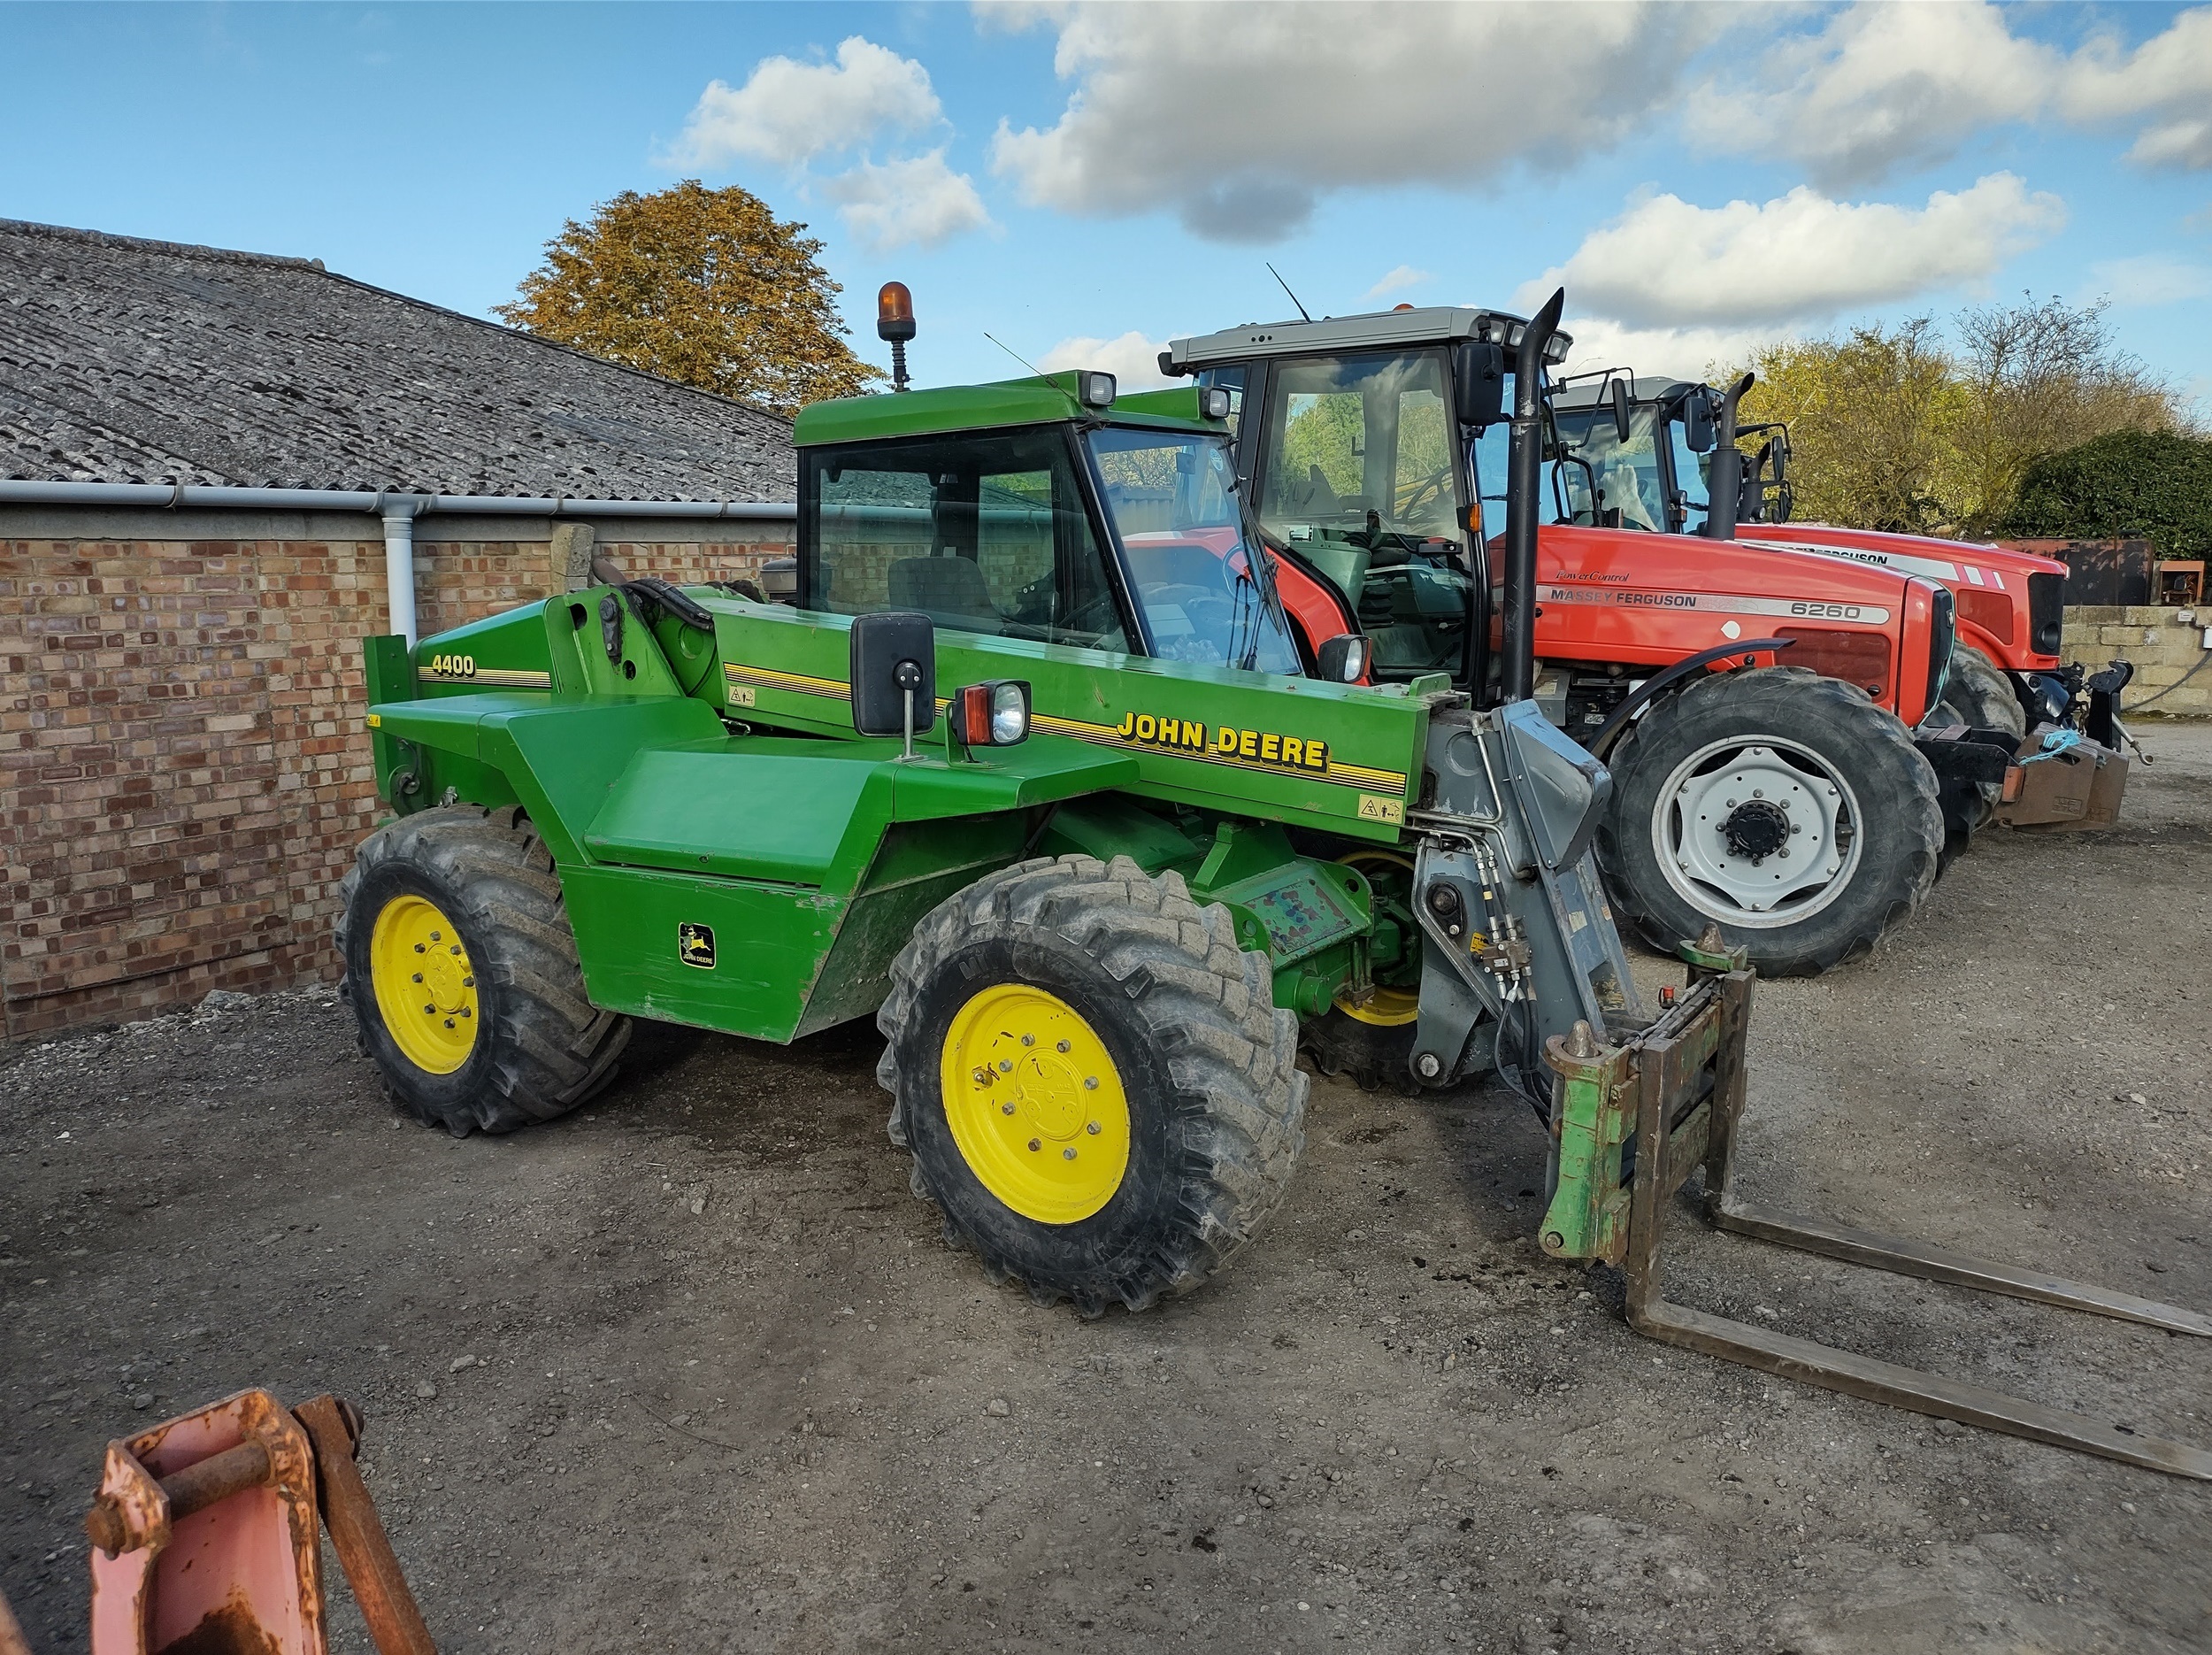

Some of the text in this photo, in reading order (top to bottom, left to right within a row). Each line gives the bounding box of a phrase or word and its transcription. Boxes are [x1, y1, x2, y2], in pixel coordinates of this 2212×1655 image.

[1555, 571, 1630, 582] PowerControl
[1551, 589, 1697, 607] MASSEY FERGUSON
[1791, 603, 1861, 620] 6260
[433, 655, 475, 676] 4400
[1117, 712, 1329, 772] JOHN DEERE
